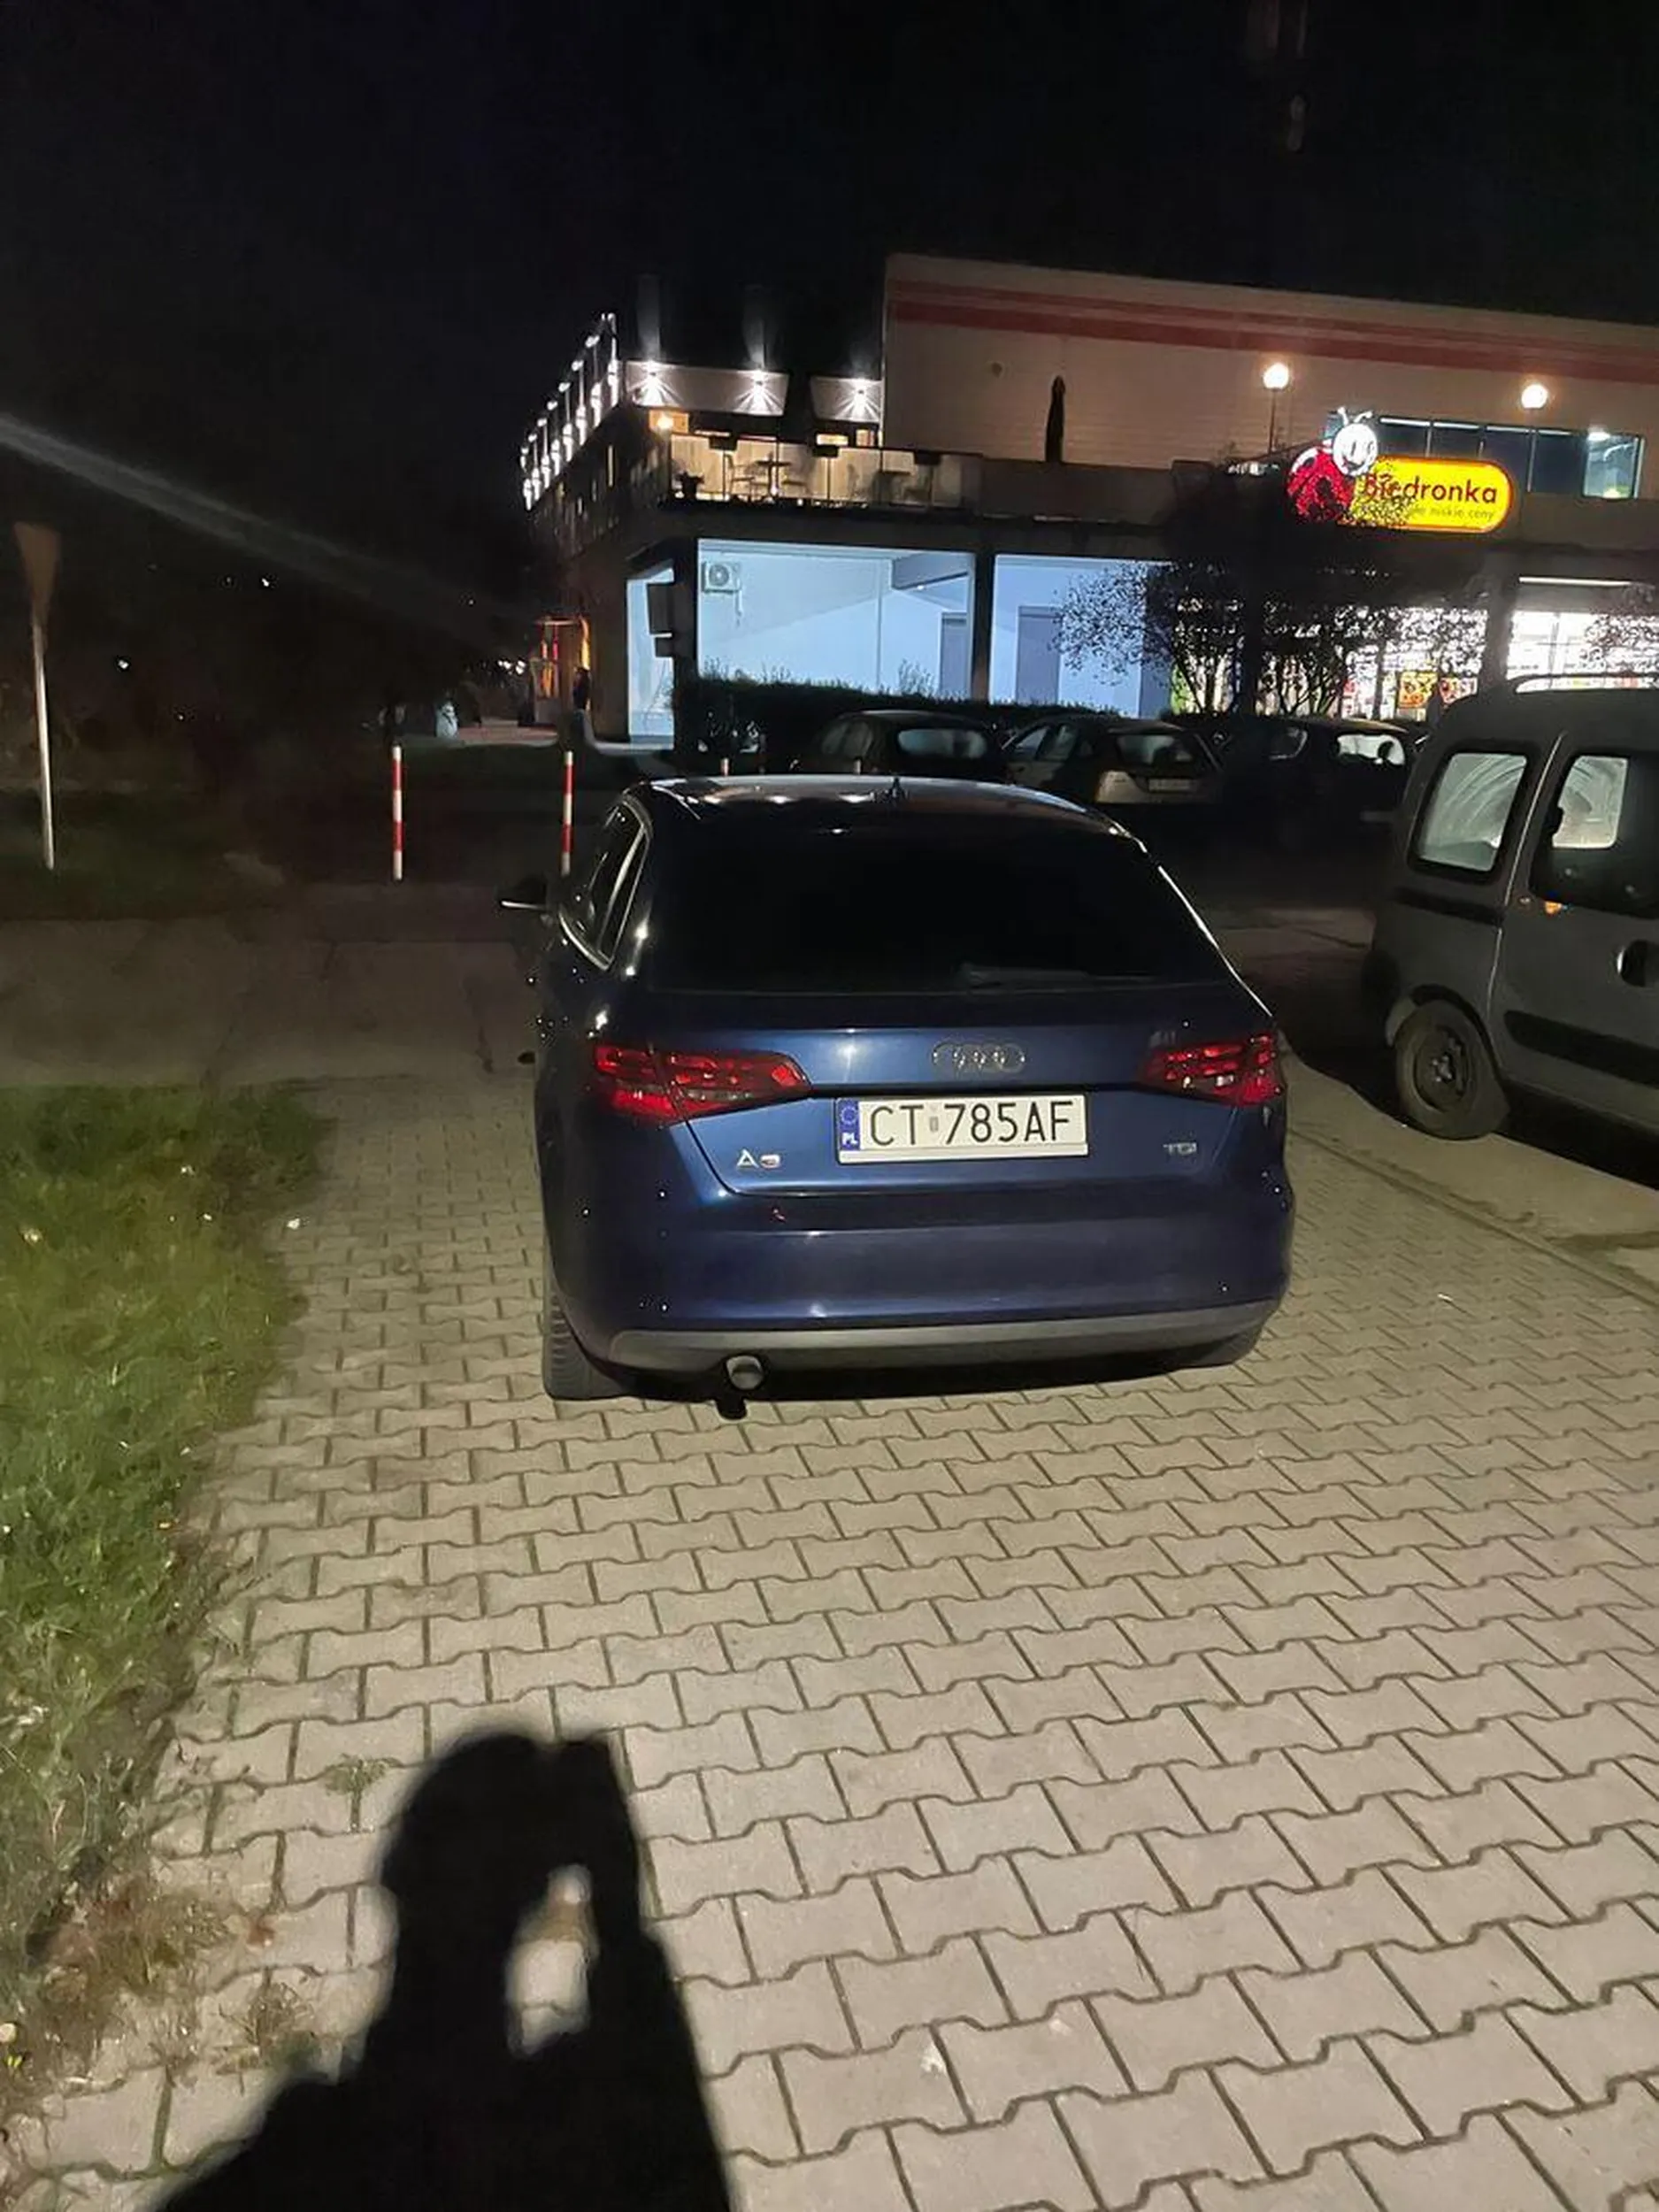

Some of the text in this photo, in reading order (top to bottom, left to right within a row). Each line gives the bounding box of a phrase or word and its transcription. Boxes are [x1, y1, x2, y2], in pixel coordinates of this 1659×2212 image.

[870, 1101, 1073, 1145] CT 785AF
[841, 1132, 858, 1146] PL
